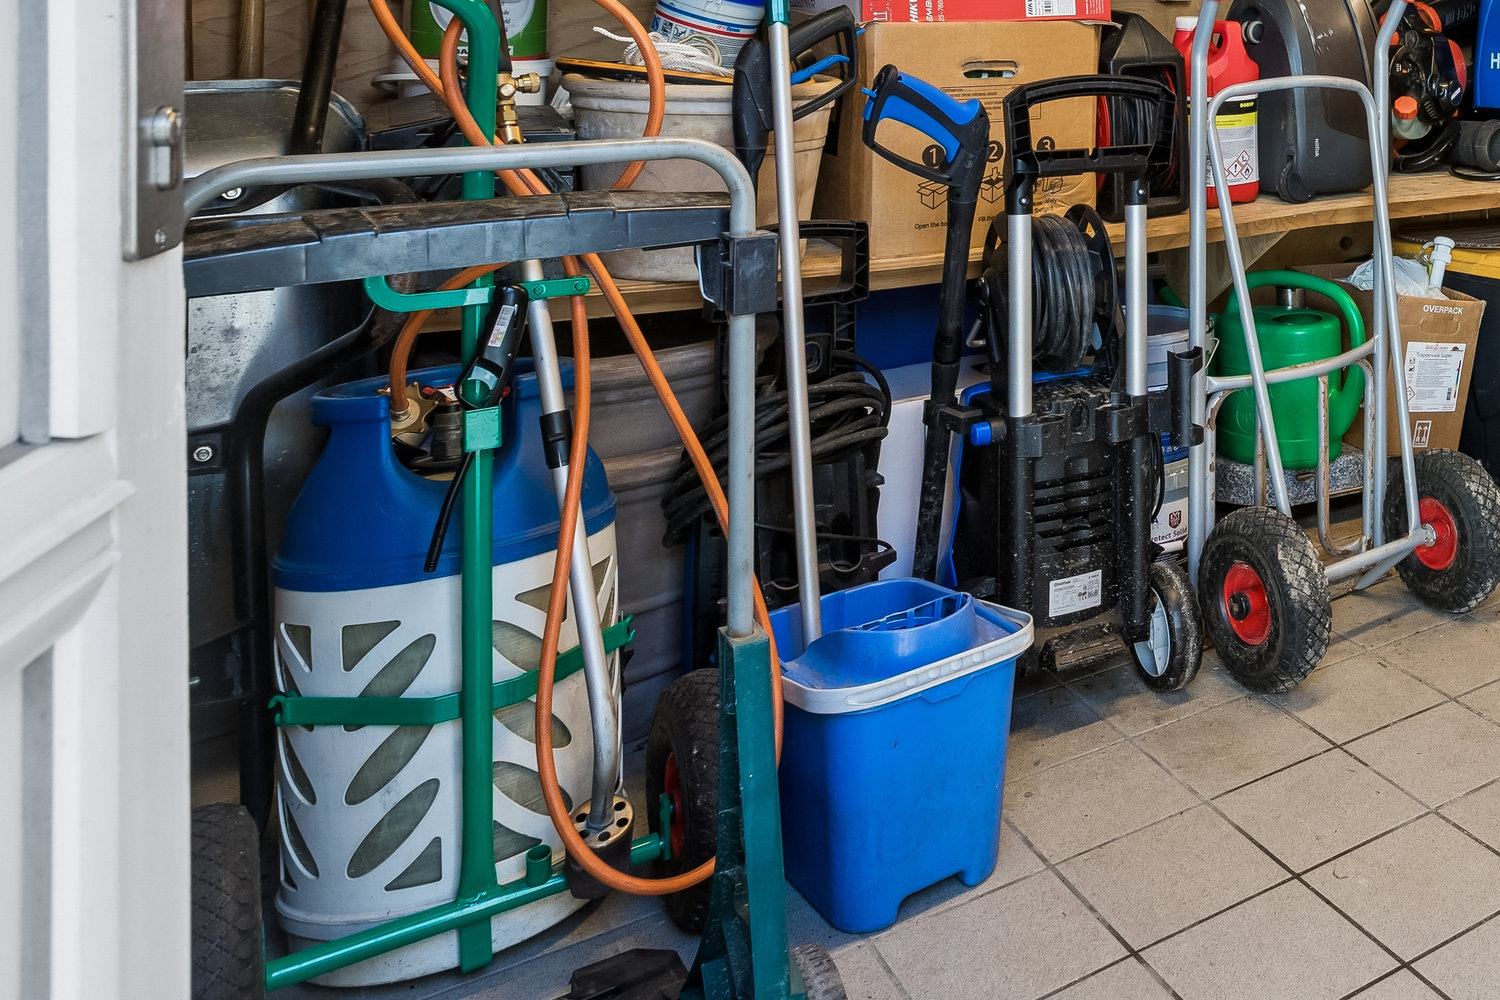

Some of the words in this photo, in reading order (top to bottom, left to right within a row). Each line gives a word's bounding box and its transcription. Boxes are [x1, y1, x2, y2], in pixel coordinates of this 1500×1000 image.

[1423, 304, 1464, 315] OVERPACK
[1151, 533, 1171, 542] rotect
[1173, 526, 1187, 536] Solid
